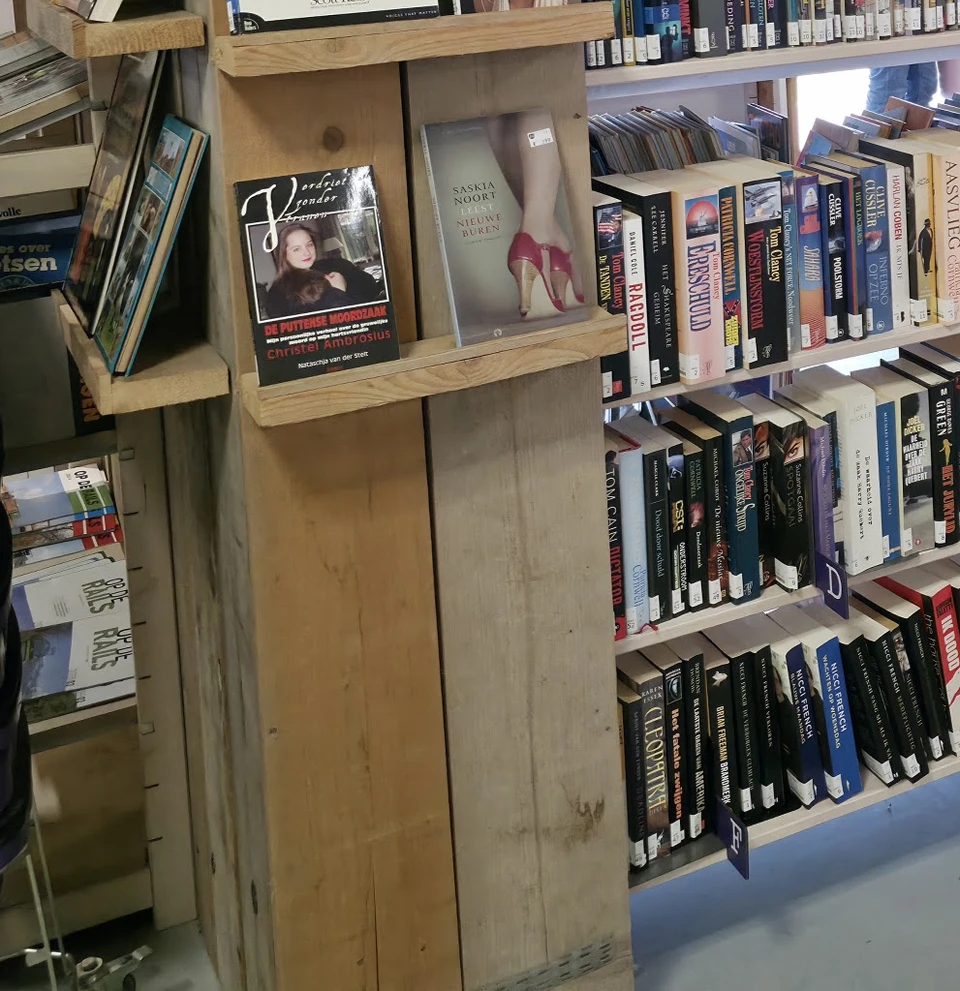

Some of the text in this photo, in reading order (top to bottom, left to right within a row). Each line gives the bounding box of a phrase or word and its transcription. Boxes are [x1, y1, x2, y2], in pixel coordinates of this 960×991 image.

[452, 181, 496, 195] SASKIA
[453, 191, 497, 206] NOORT
[461, 203, 494, 216] LEEST
[864, 179, 878, 228] CUSSLER
[875, 185, 887, 219] CLIVE
[456, 213, 502, 228] NIEUWE
[461, 224, 500, 238] BUREN
[828, 193, 837, 227] CUSSLER
[18, 244, 52, 254] over
[721, 196, 737, 296] PATRICIA CORNWELL
[769, 226, 784, 283] Tom Clancy
[803, 245, 821, 282] SAHARA
[612, 252, 626, 309] Tom Clancy
[688, 240, 718, 333] ERESCHULD
[711, 252, 722, 300] Tom Clancy
[747, 229, 766, 331] WOESTIJNSTORM
[832, 257, 843, 300] POOLSTORM
[264, 324, 279, 337] DE
[280, 315, 328, 334] PUTTENSE
[329, 305, 388, 325] MOORDZAAK
[629, 283, 647, 351] RAGDOLL
[266, 341, 321, 361] Christel
[323, 329, 392, 351] Ambrosius
[936, 400, 948, 437] GREEN
[80, 578, 116, 615] RAILS
[825, 562, 842, 600] D
[90, 626, 120, 672] RAILS
[940, 614, 960, 672] IK DOOD
[796, 668, 814, 740] NICCI FRENCH
[830, 662, 848, 733] NICCI FRENCH
[644, 706, 668, 811] CLEOPATRA
[671, 707, 685, 819] Het fatale zwijgen
[716, 705, 732, 805] BRIAN FREEMAN BRANDMERK
[729, 817, 743, 855] F
